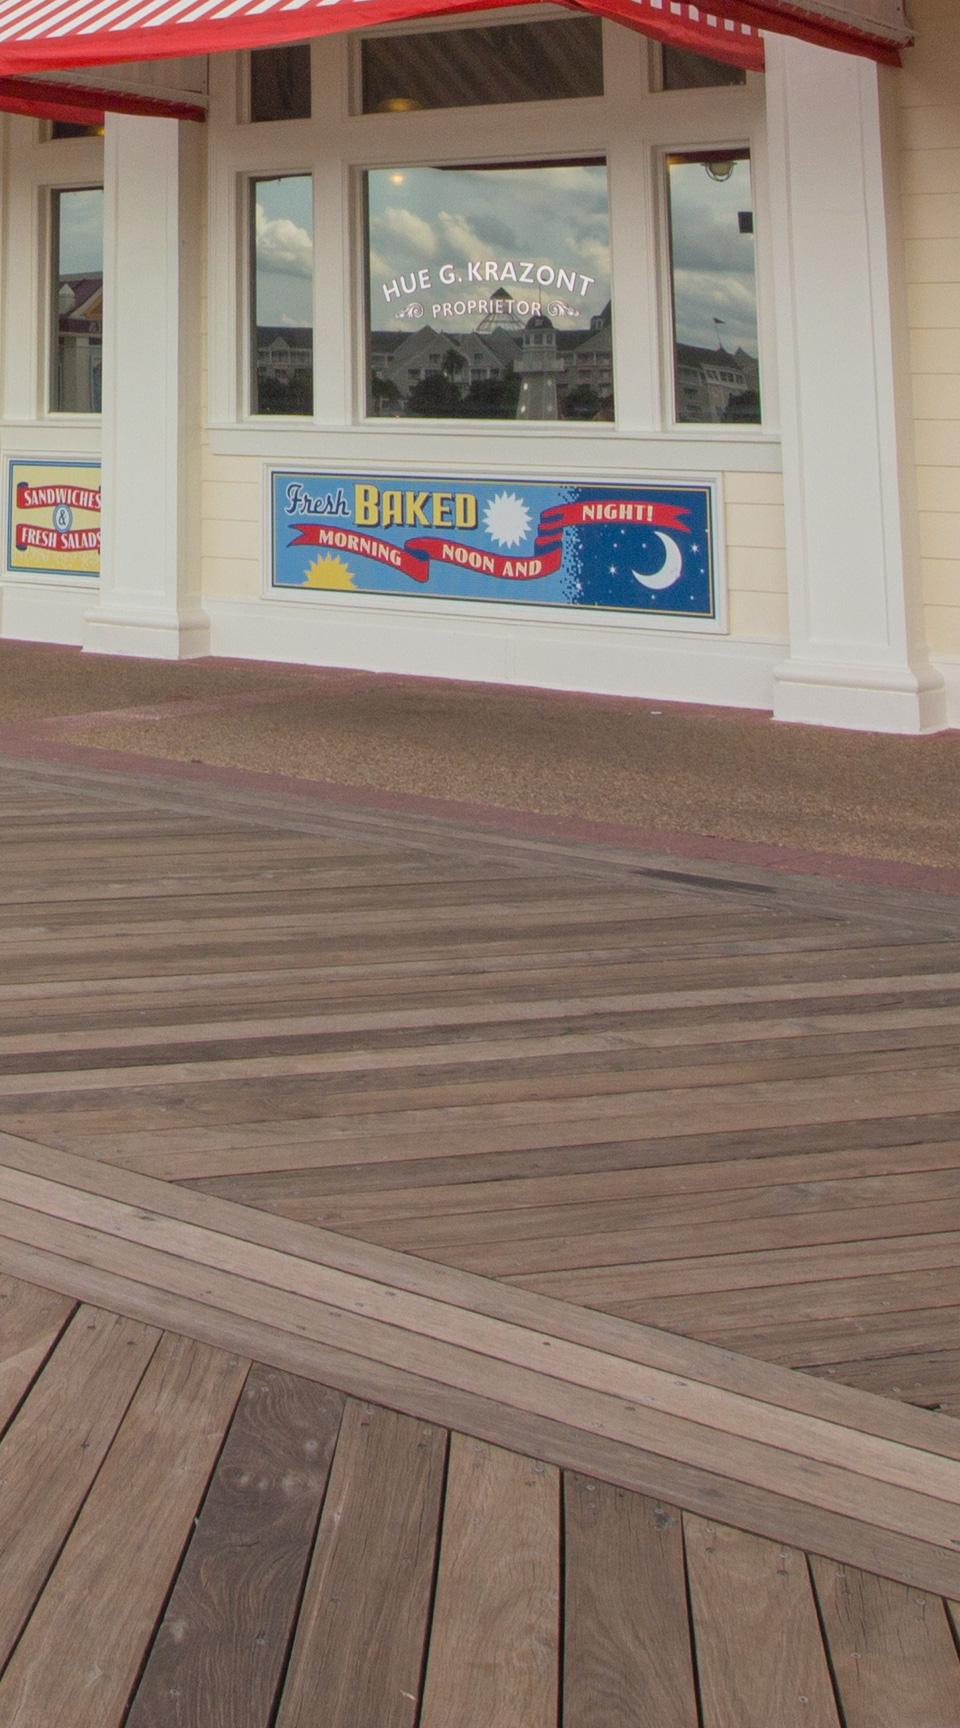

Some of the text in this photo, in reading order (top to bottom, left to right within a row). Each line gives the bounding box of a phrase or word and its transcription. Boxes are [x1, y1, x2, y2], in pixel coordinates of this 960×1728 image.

[382, 261, 595, 302] HUE G. KRAZONT
[432, 298, 542, 319] PROPRIETOR
[58, 509, 67, 526] &
[284, 482, 479, 530] Fresh BAKED
[21, 527, 57, 548] FRESH
[318, 503, 654, 578] MORNING NOON AND NIGHT!
